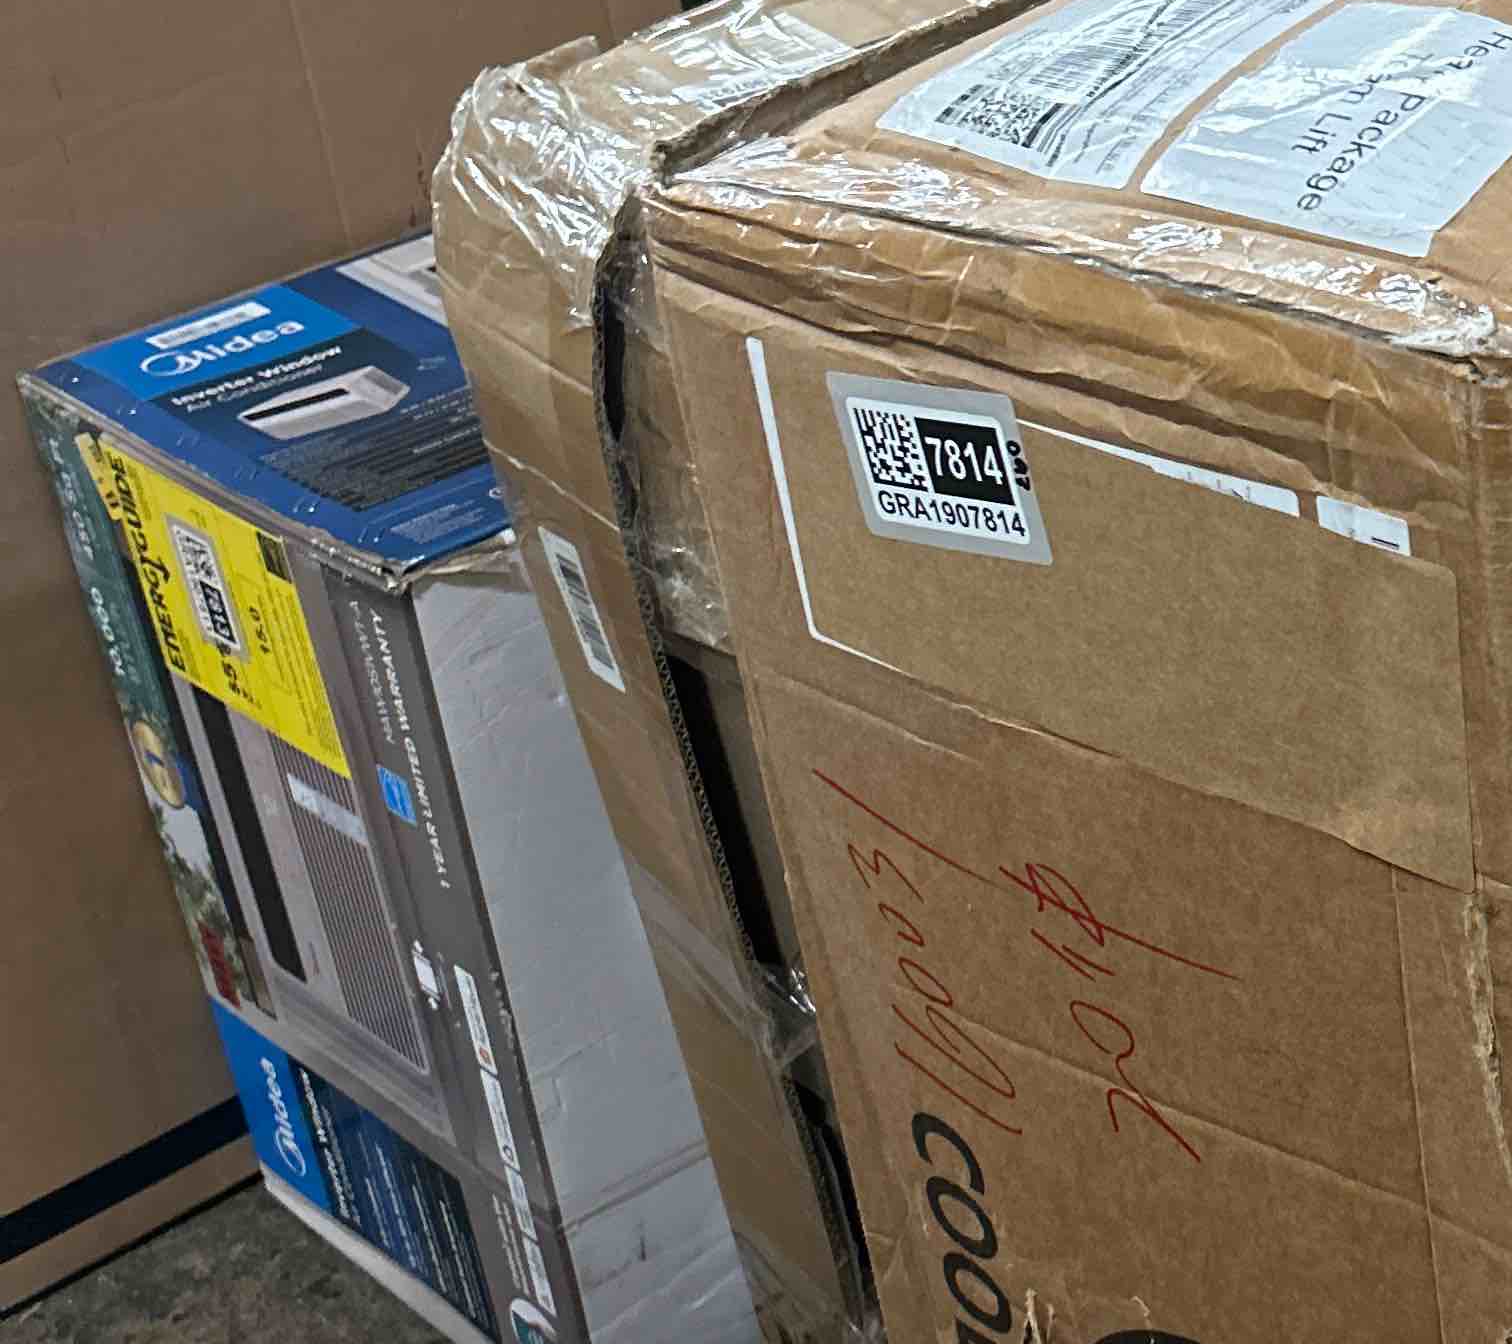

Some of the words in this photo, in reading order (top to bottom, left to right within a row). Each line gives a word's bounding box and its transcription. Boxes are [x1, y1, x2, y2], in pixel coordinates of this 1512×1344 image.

[1291, 112, 1353, 154] Lift
[1296, 91, 1427, 211] Package
[140, 320, 305, 377] Midea
[924, 436, 1004, 486] 7814
[878, 490, 1026, 537] GRA1907814
[259, 1056, 307, 1177] Midea
